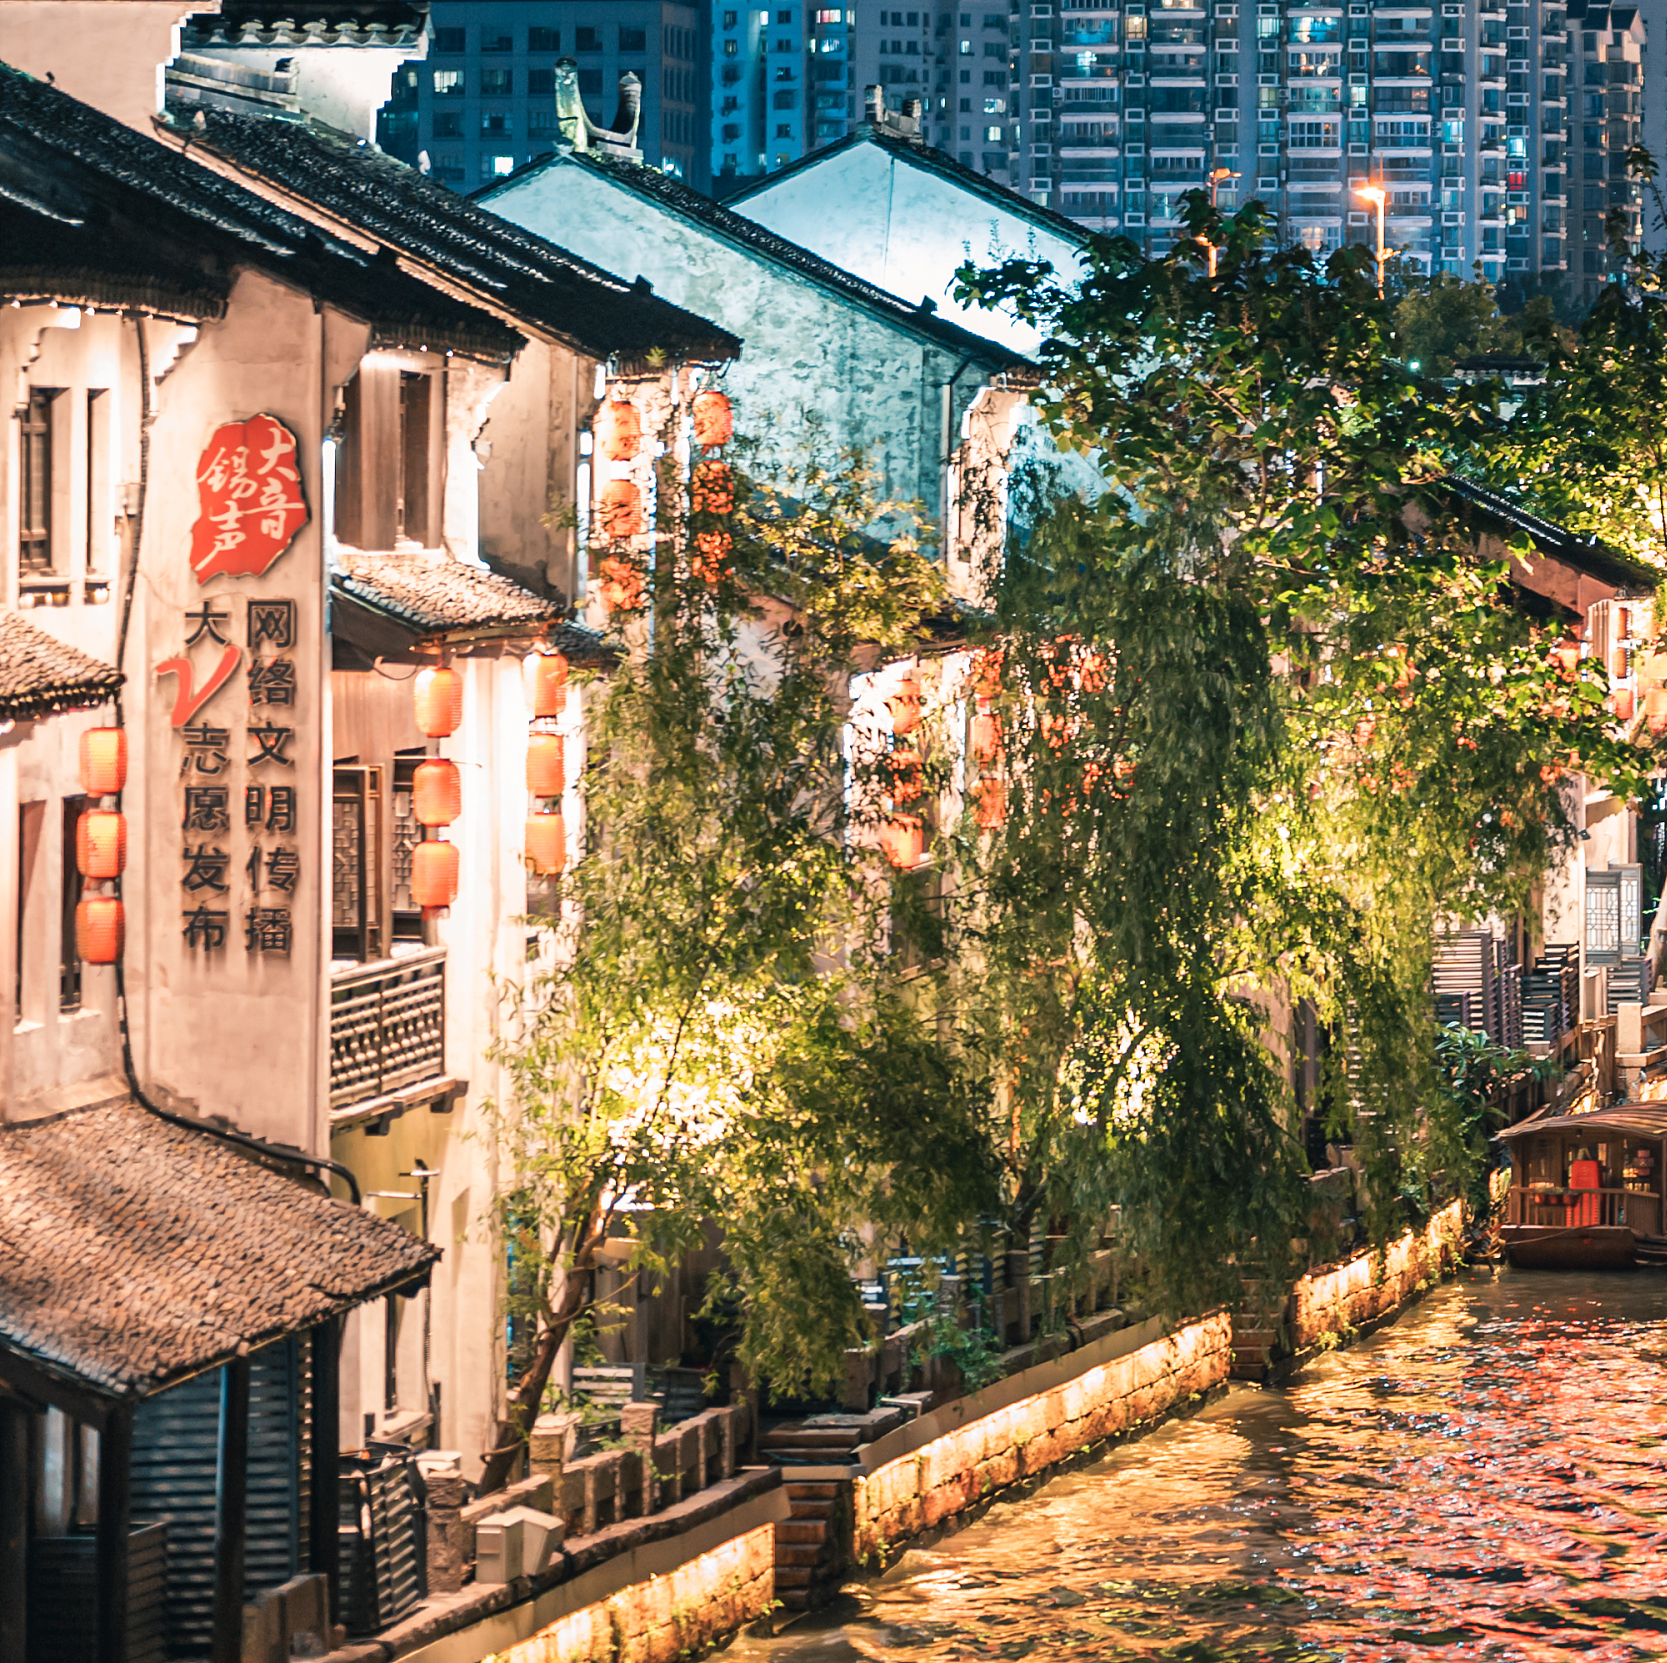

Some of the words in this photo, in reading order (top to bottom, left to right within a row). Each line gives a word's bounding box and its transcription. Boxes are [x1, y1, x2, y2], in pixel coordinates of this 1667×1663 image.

[245, 599, 299, 953] 网络文明传播
